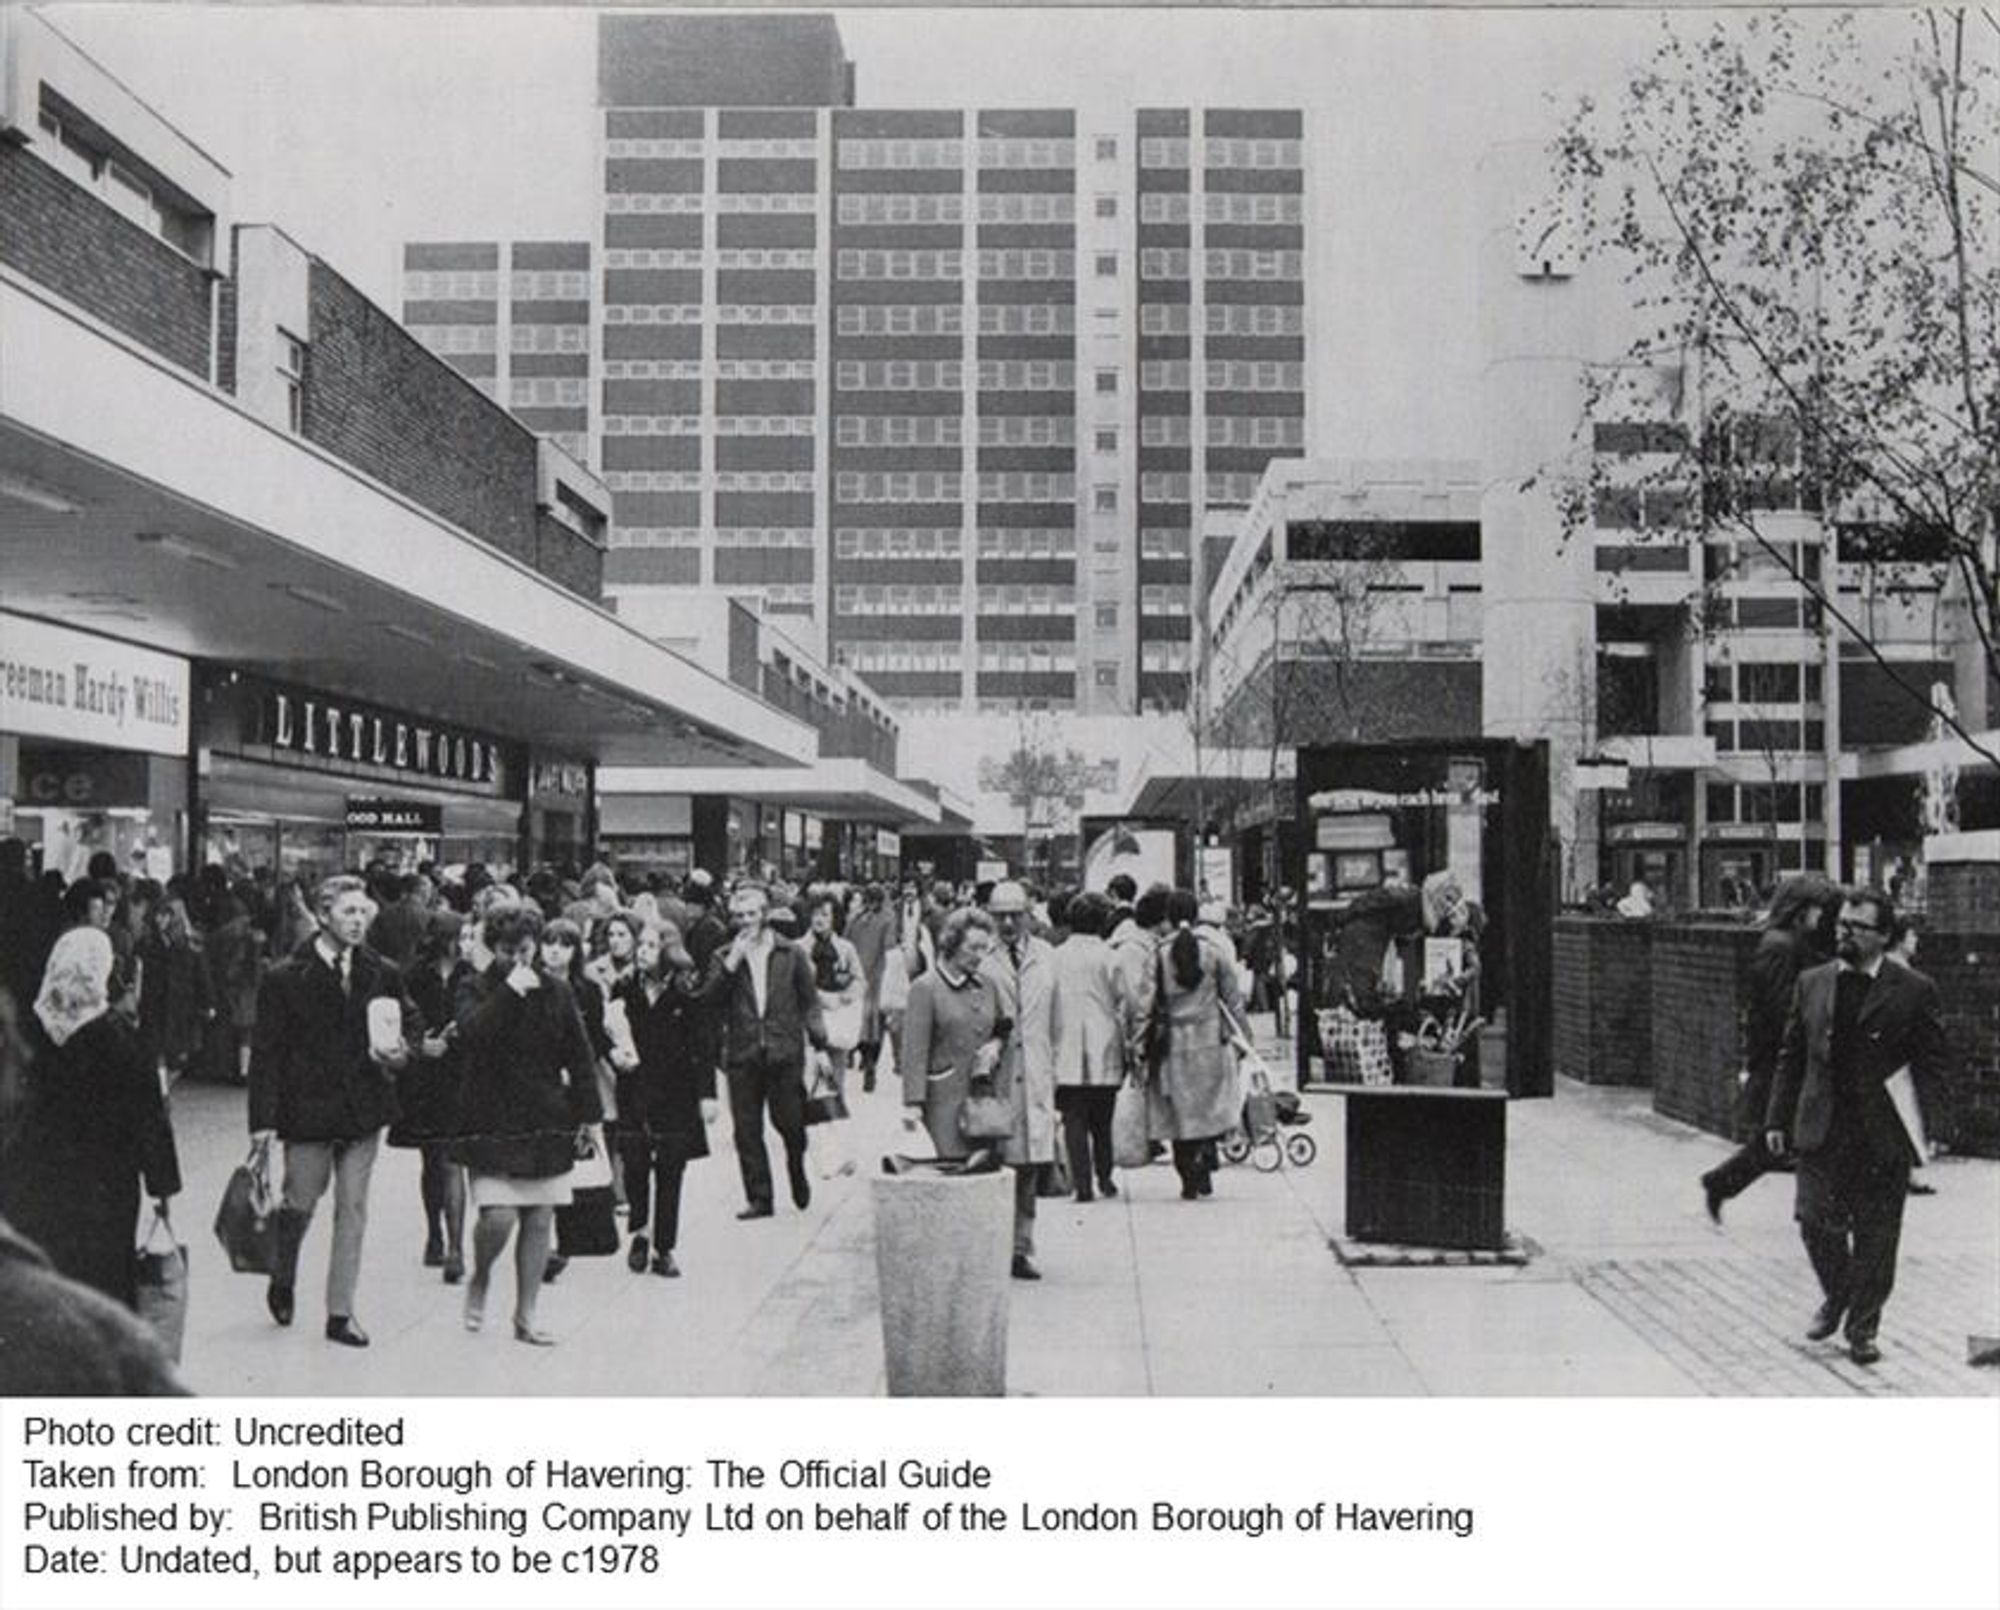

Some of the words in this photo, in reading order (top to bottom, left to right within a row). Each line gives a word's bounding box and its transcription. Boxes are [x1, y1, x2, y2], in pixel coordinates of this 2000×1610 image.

[74, 662, 127, 728] Hardy
[133, 675, 180, 727] Willis
[276, 694, 499, 783] LITTLEWOODS
